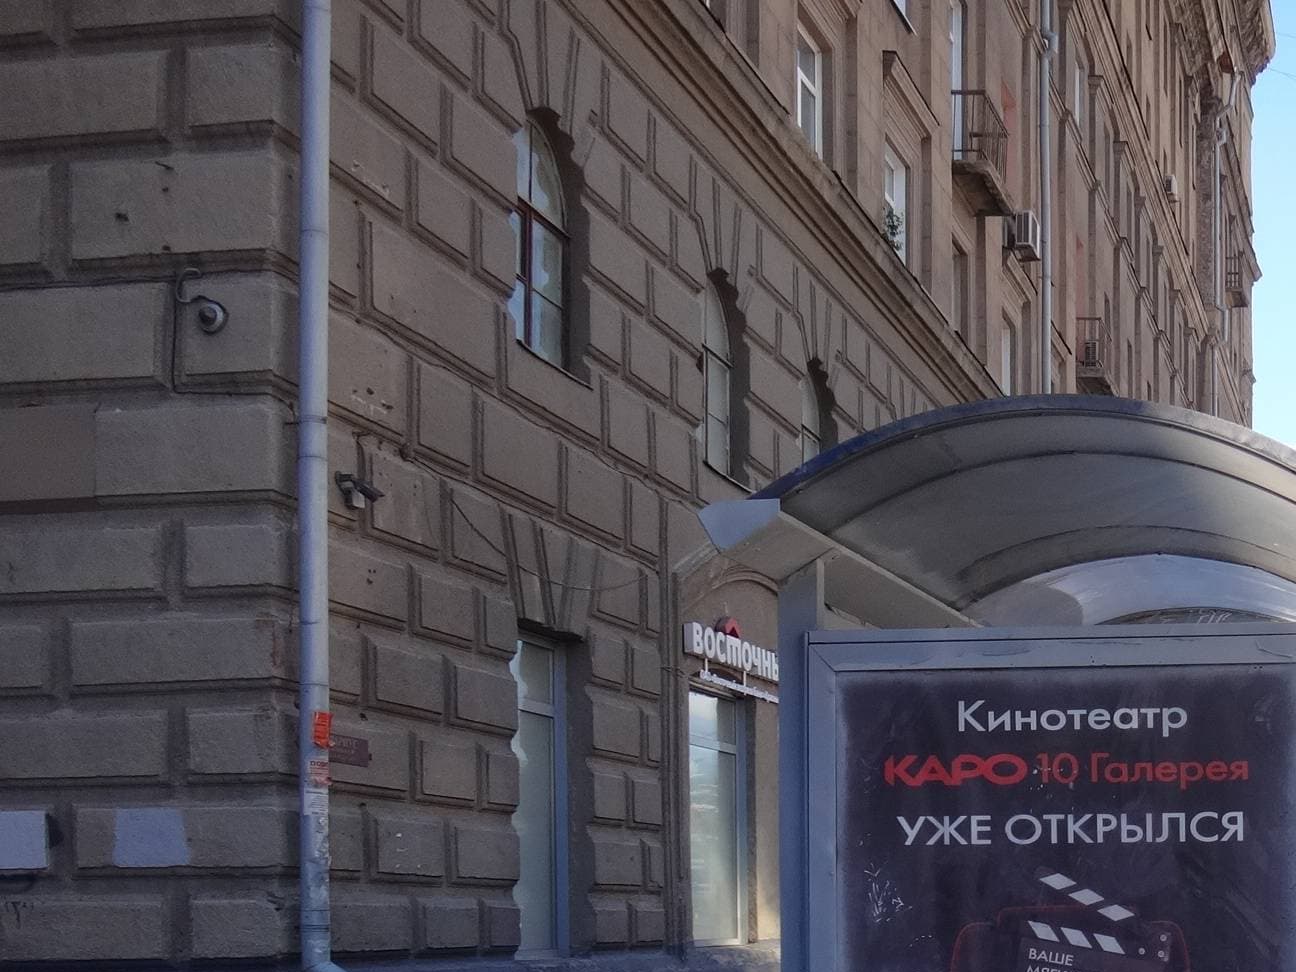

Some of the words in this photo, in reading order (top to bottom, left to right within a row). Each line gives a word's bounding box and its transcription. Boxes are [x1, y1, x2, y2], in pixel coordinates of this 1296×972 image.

[957, 699, 1189, 737] Кинотеатр
[884, 753, 1028, 788] КАРО
[1036, 752, 1079, 784] 10
[1090, 751, 1250, 790] Галерея
[896, 814, 992, 846] УЖЕ
[1003, 810, 1244, 846] ОТКРЫЛСЯ
[1028, 947, 1075, 967] ВАШЕ
